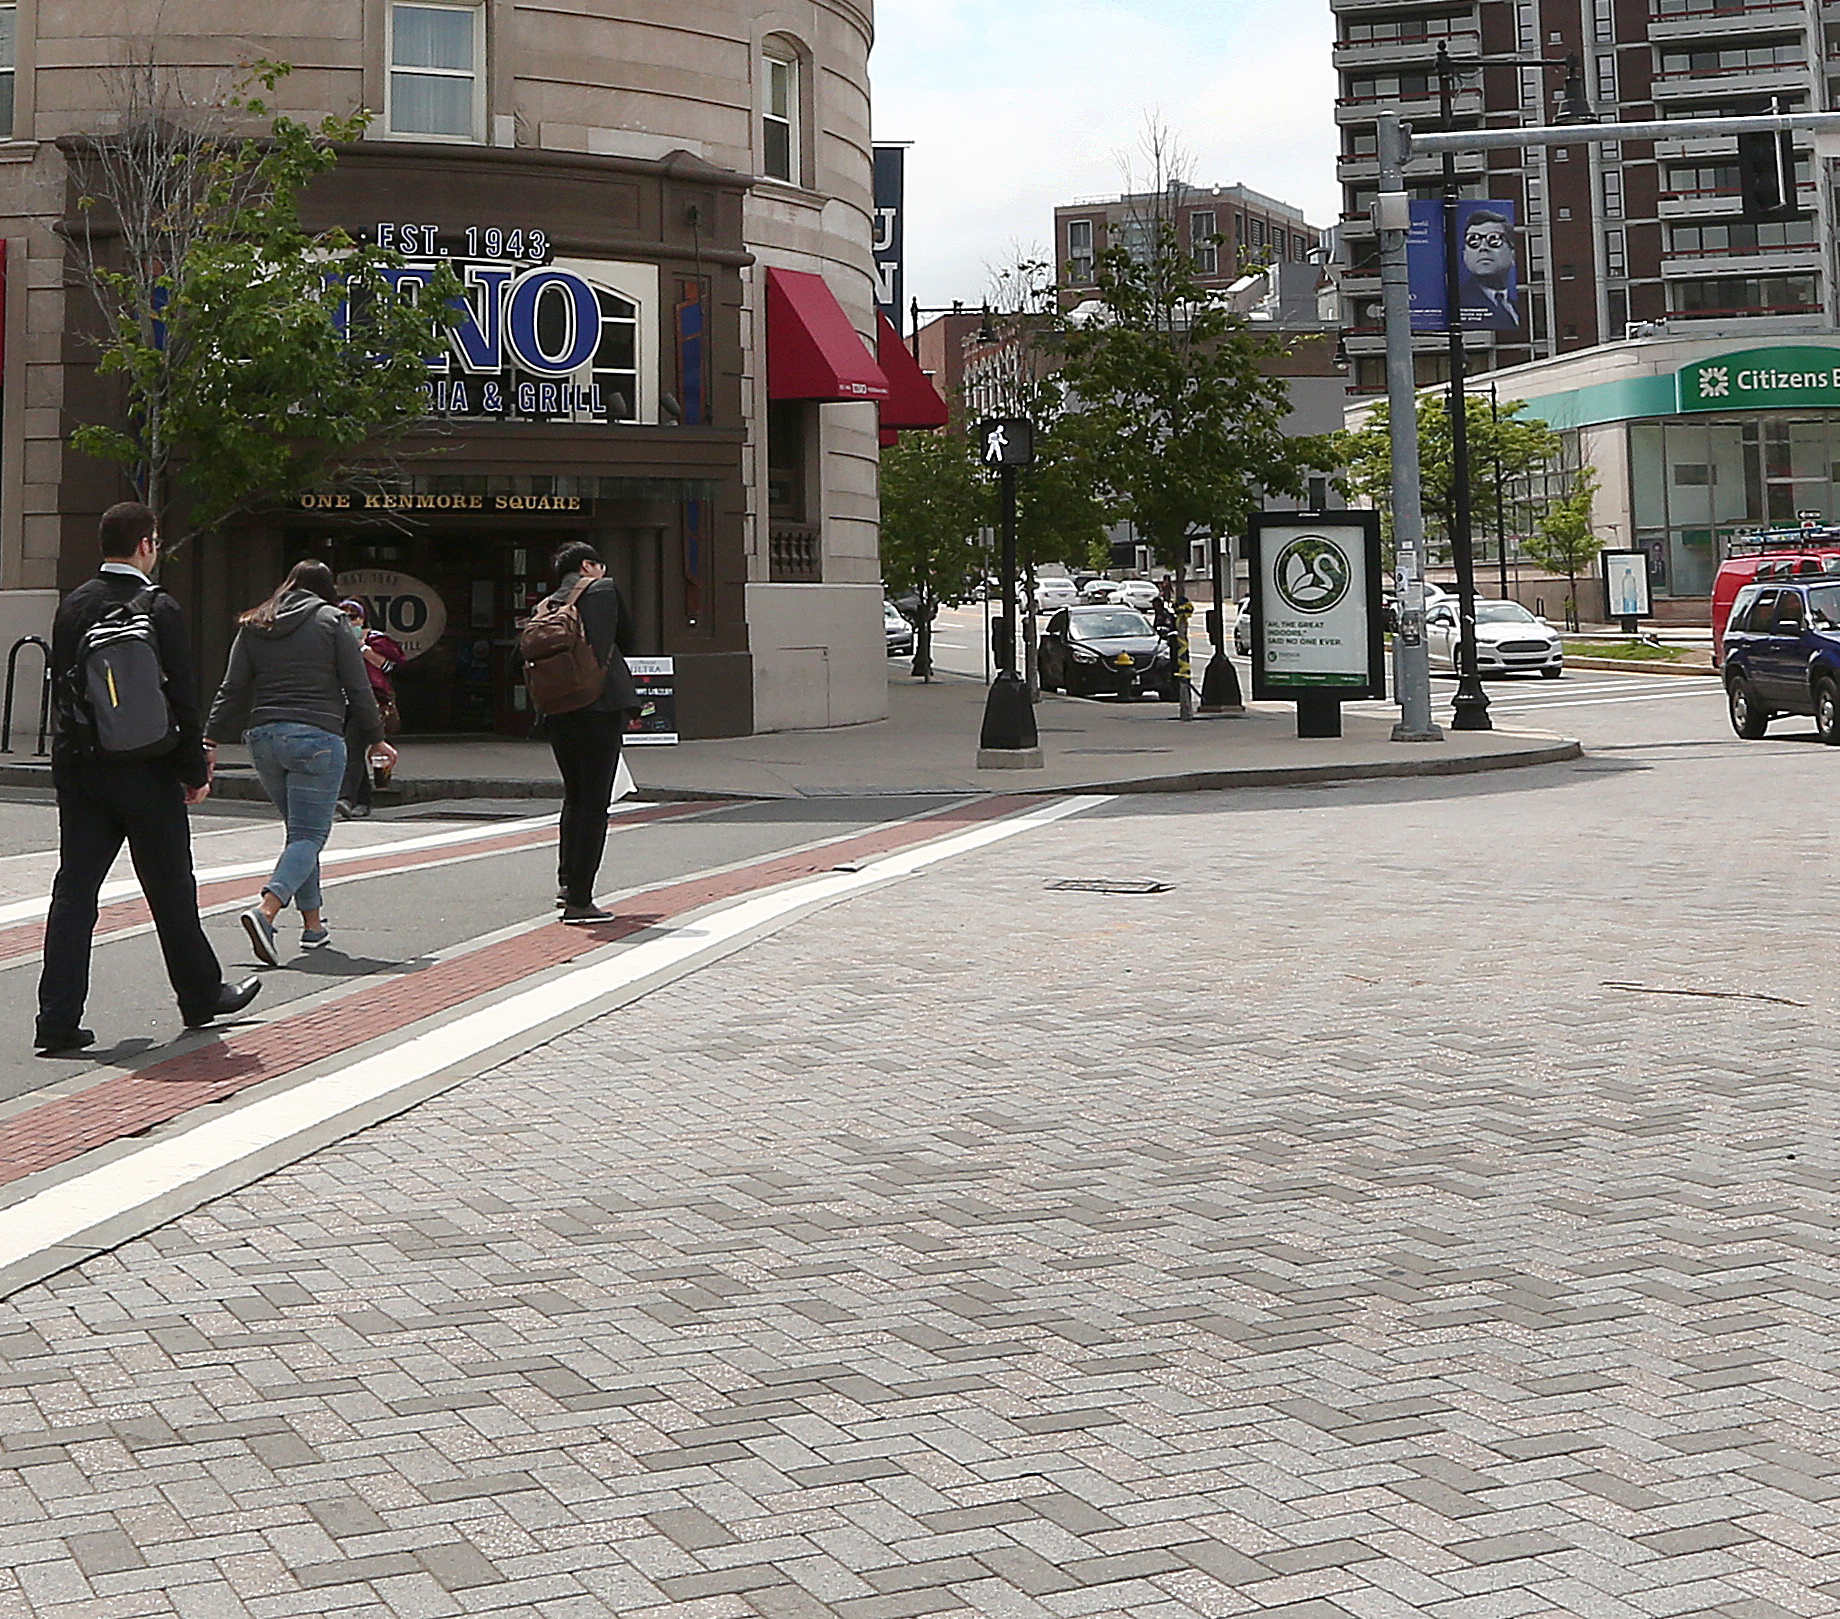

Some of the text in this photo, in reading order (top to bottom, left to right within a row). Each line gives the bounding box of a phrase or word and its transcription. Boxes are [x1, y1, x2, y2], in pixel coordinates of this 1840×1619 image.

[377, 223, 546, 259] EST. 1943
[1737, 368, 1828, 390] Citizens
[483, 381, 503, 413] &
[518, 384, 606, 412] GRILL
[301, 494, 581, 510] ONE KENMORE SQUARE
[1281, 621, 1296, 629] THE
[1297, 621, 1324, 629] GREAT
[1267, 637, 1284, 646] SAID
[1286, 637, 1298, 646] NO
[1300, 637, 1317, 646] ONE
